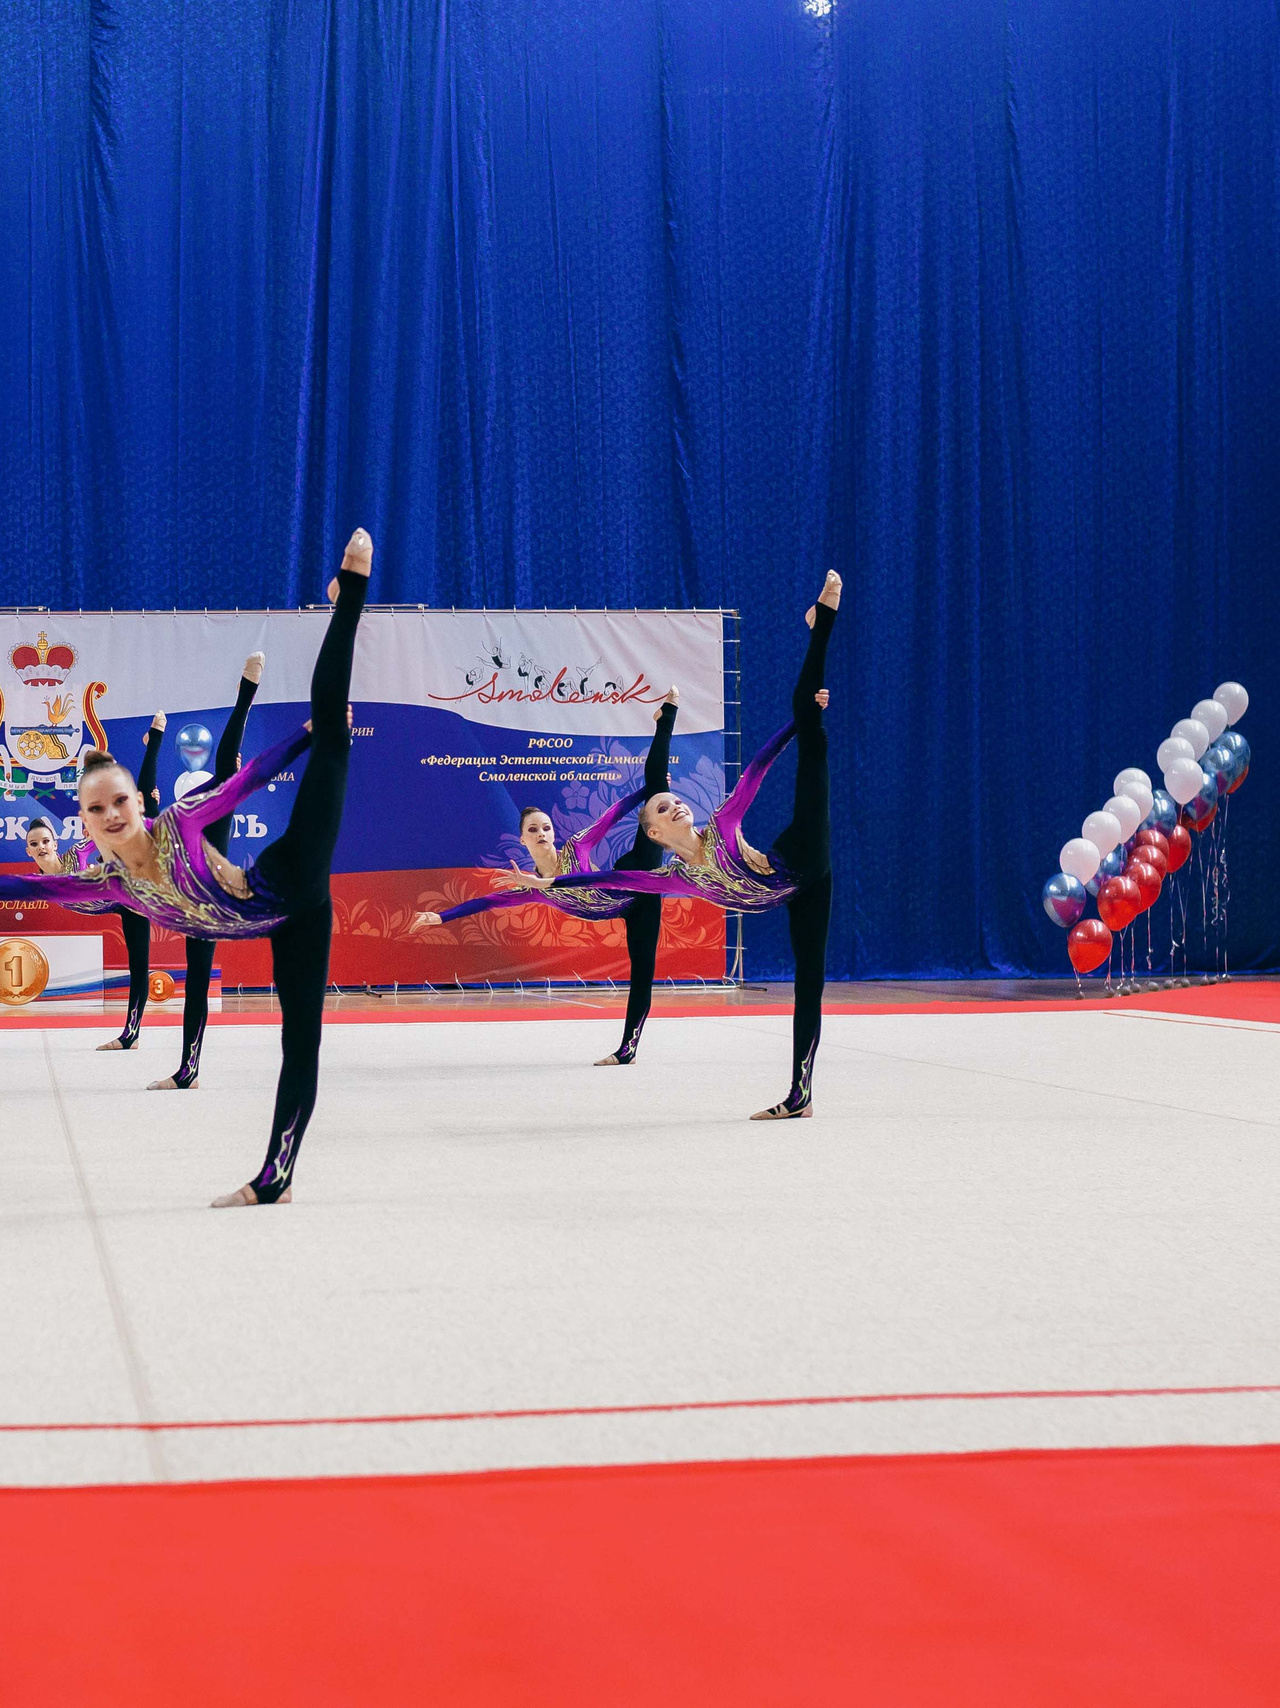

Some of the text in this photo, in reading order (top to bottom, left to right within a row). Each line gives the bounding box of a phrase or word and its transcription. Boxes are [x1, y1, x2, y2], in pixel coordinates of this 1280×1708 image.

[527, 738, 574, 749] РФСОО
[420, 753, 680, 767] «Федерация Эстетической Гимнаси
[478, 770, 623, 782] Смоленской области»
[4, 955, 23, 988] 1
[152, 979, 165, 994] 3
